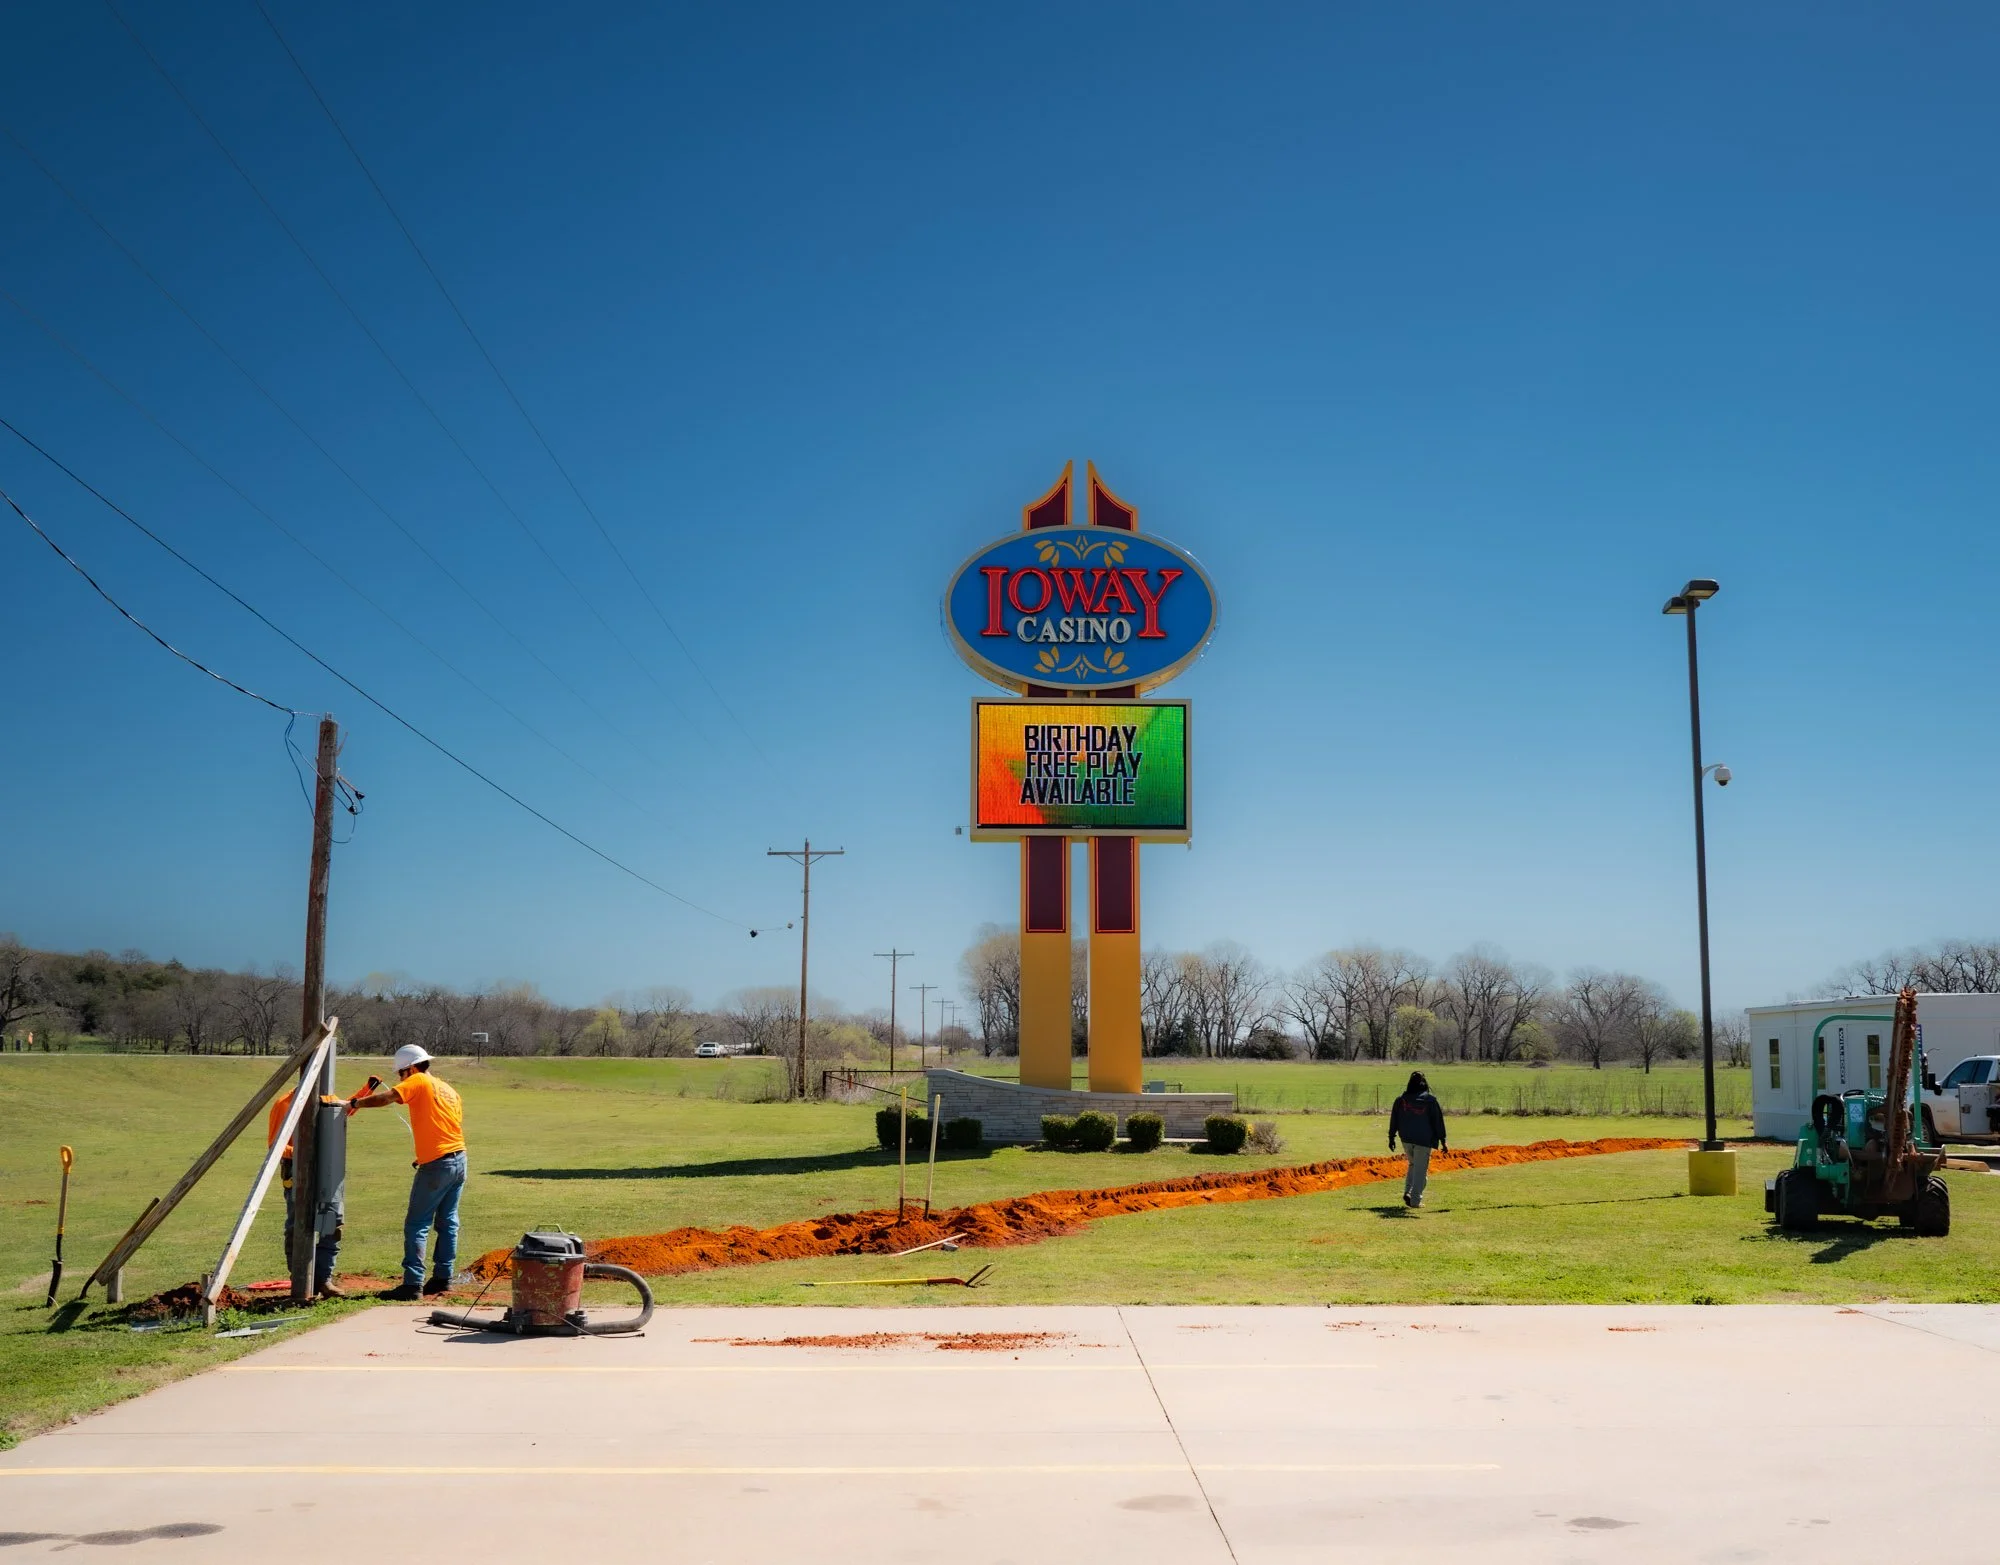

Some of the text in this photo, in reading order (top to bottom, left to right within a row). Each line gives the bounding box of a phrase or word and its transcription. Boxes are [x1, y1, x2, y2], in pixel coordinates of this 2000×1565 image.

[980, 567, 1184, 638] IOWAY
[1016, 616, 1132, 643] CASINO
[1023, 724, 1138, 752] BIRTHDAY
[1026, 751, 1143, 779] FREE PLAY
[1019, 777, 1136, 806] AVAILABLE
